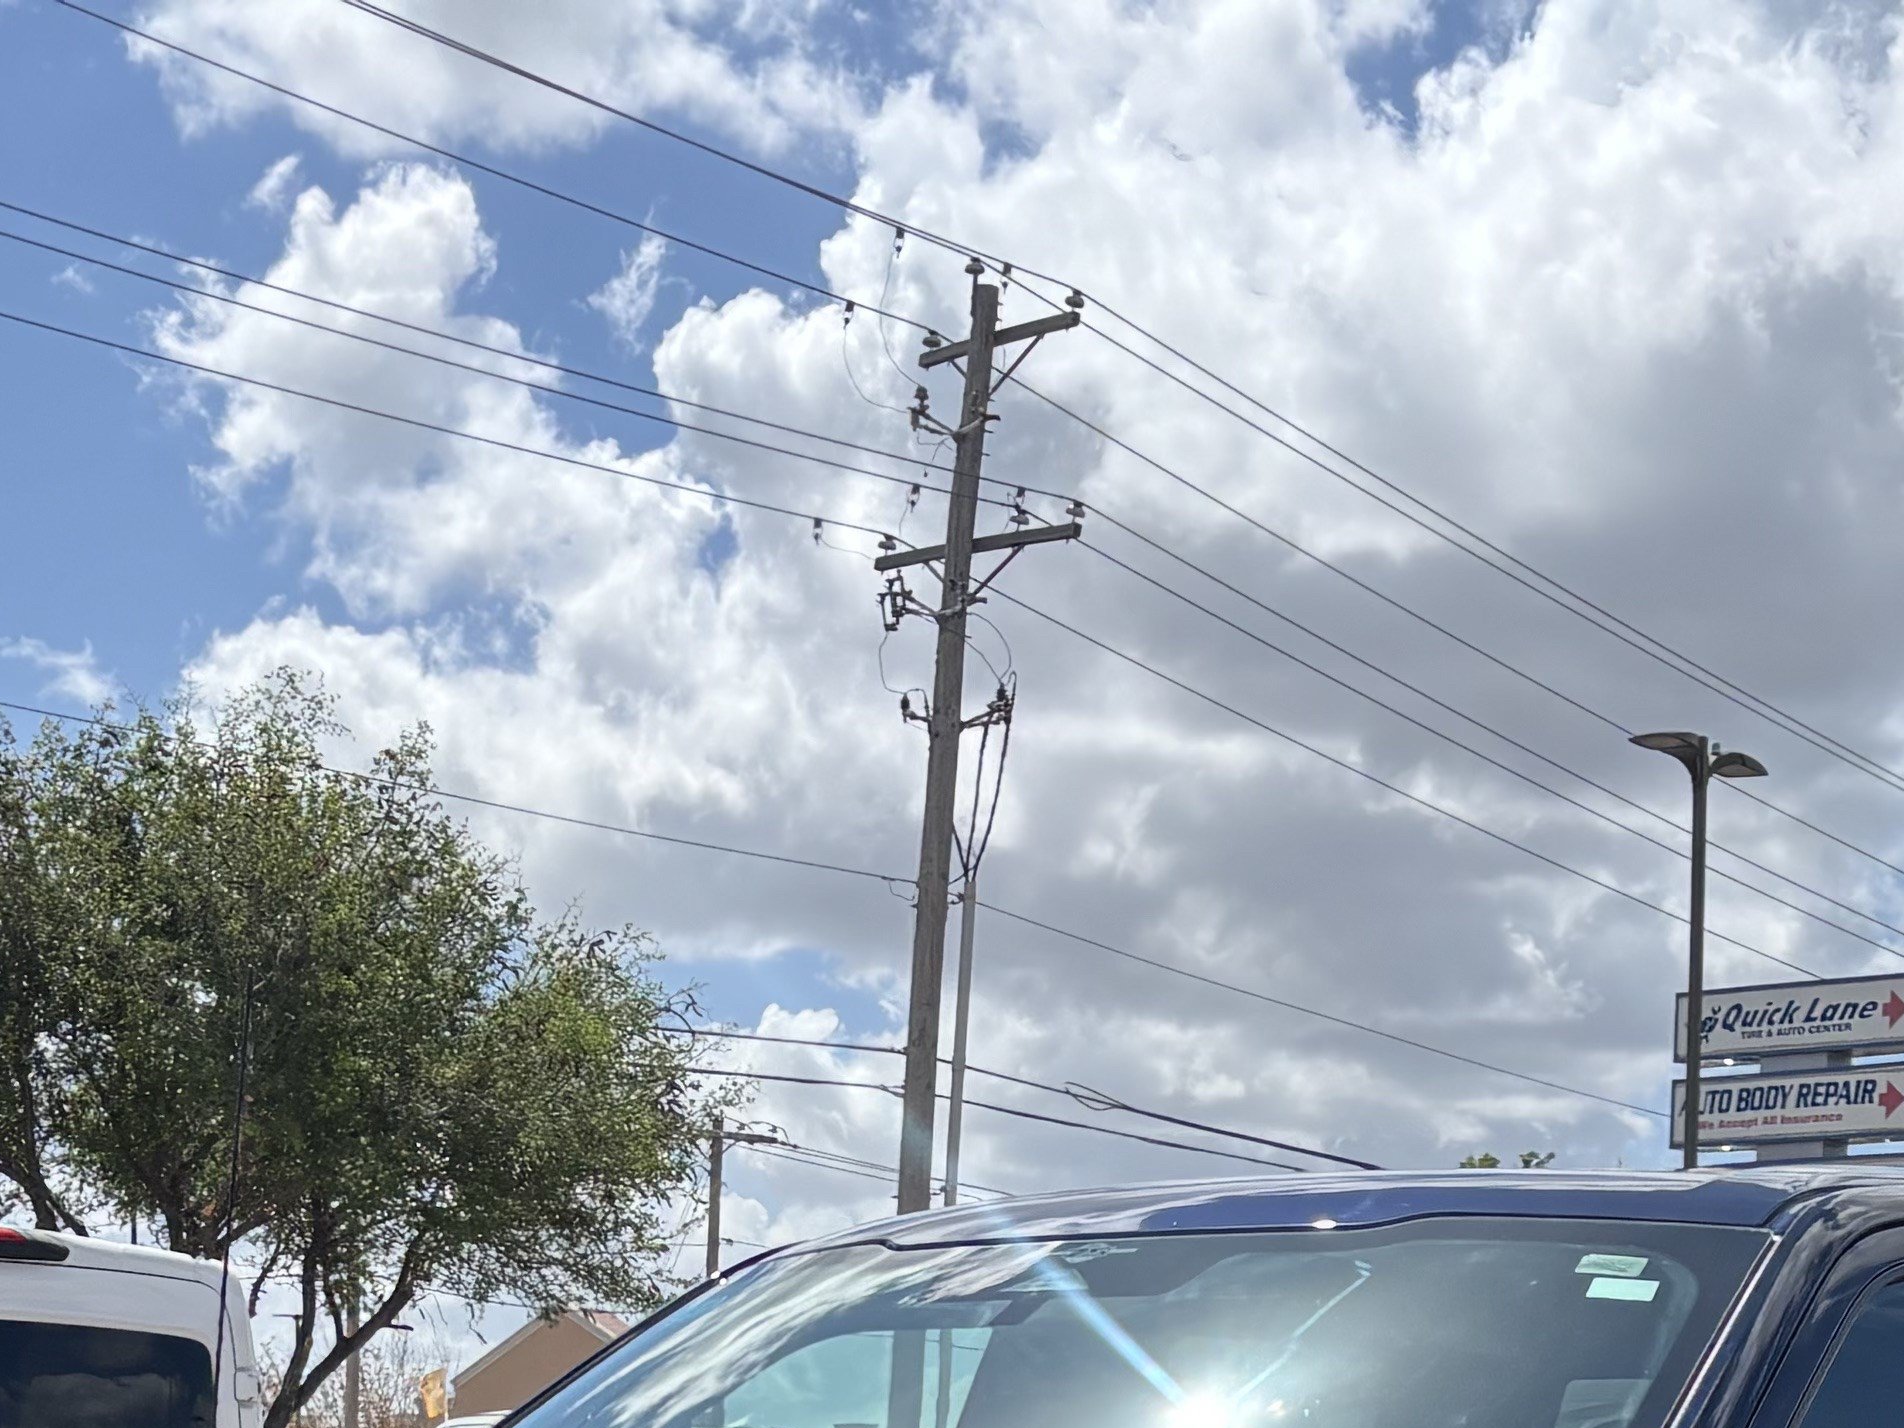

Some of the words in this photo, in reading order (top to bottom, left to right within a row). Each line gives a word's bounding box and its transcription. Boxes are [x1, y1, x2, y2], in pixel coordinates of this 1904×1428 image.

[1722, 999, 1802, 1033] Quick
[1804, 997, 1879, 1024] Lane
[1776, 1025, 1805, 1036] AUTO
[1808, 1023, 1852, 1035] CENTER
[1736, 1083, 1794, 1113] BODY
[1795, 1078, 1878, 1109] REPAIR
[1780, 1112, 1844, 1125] Insurance
